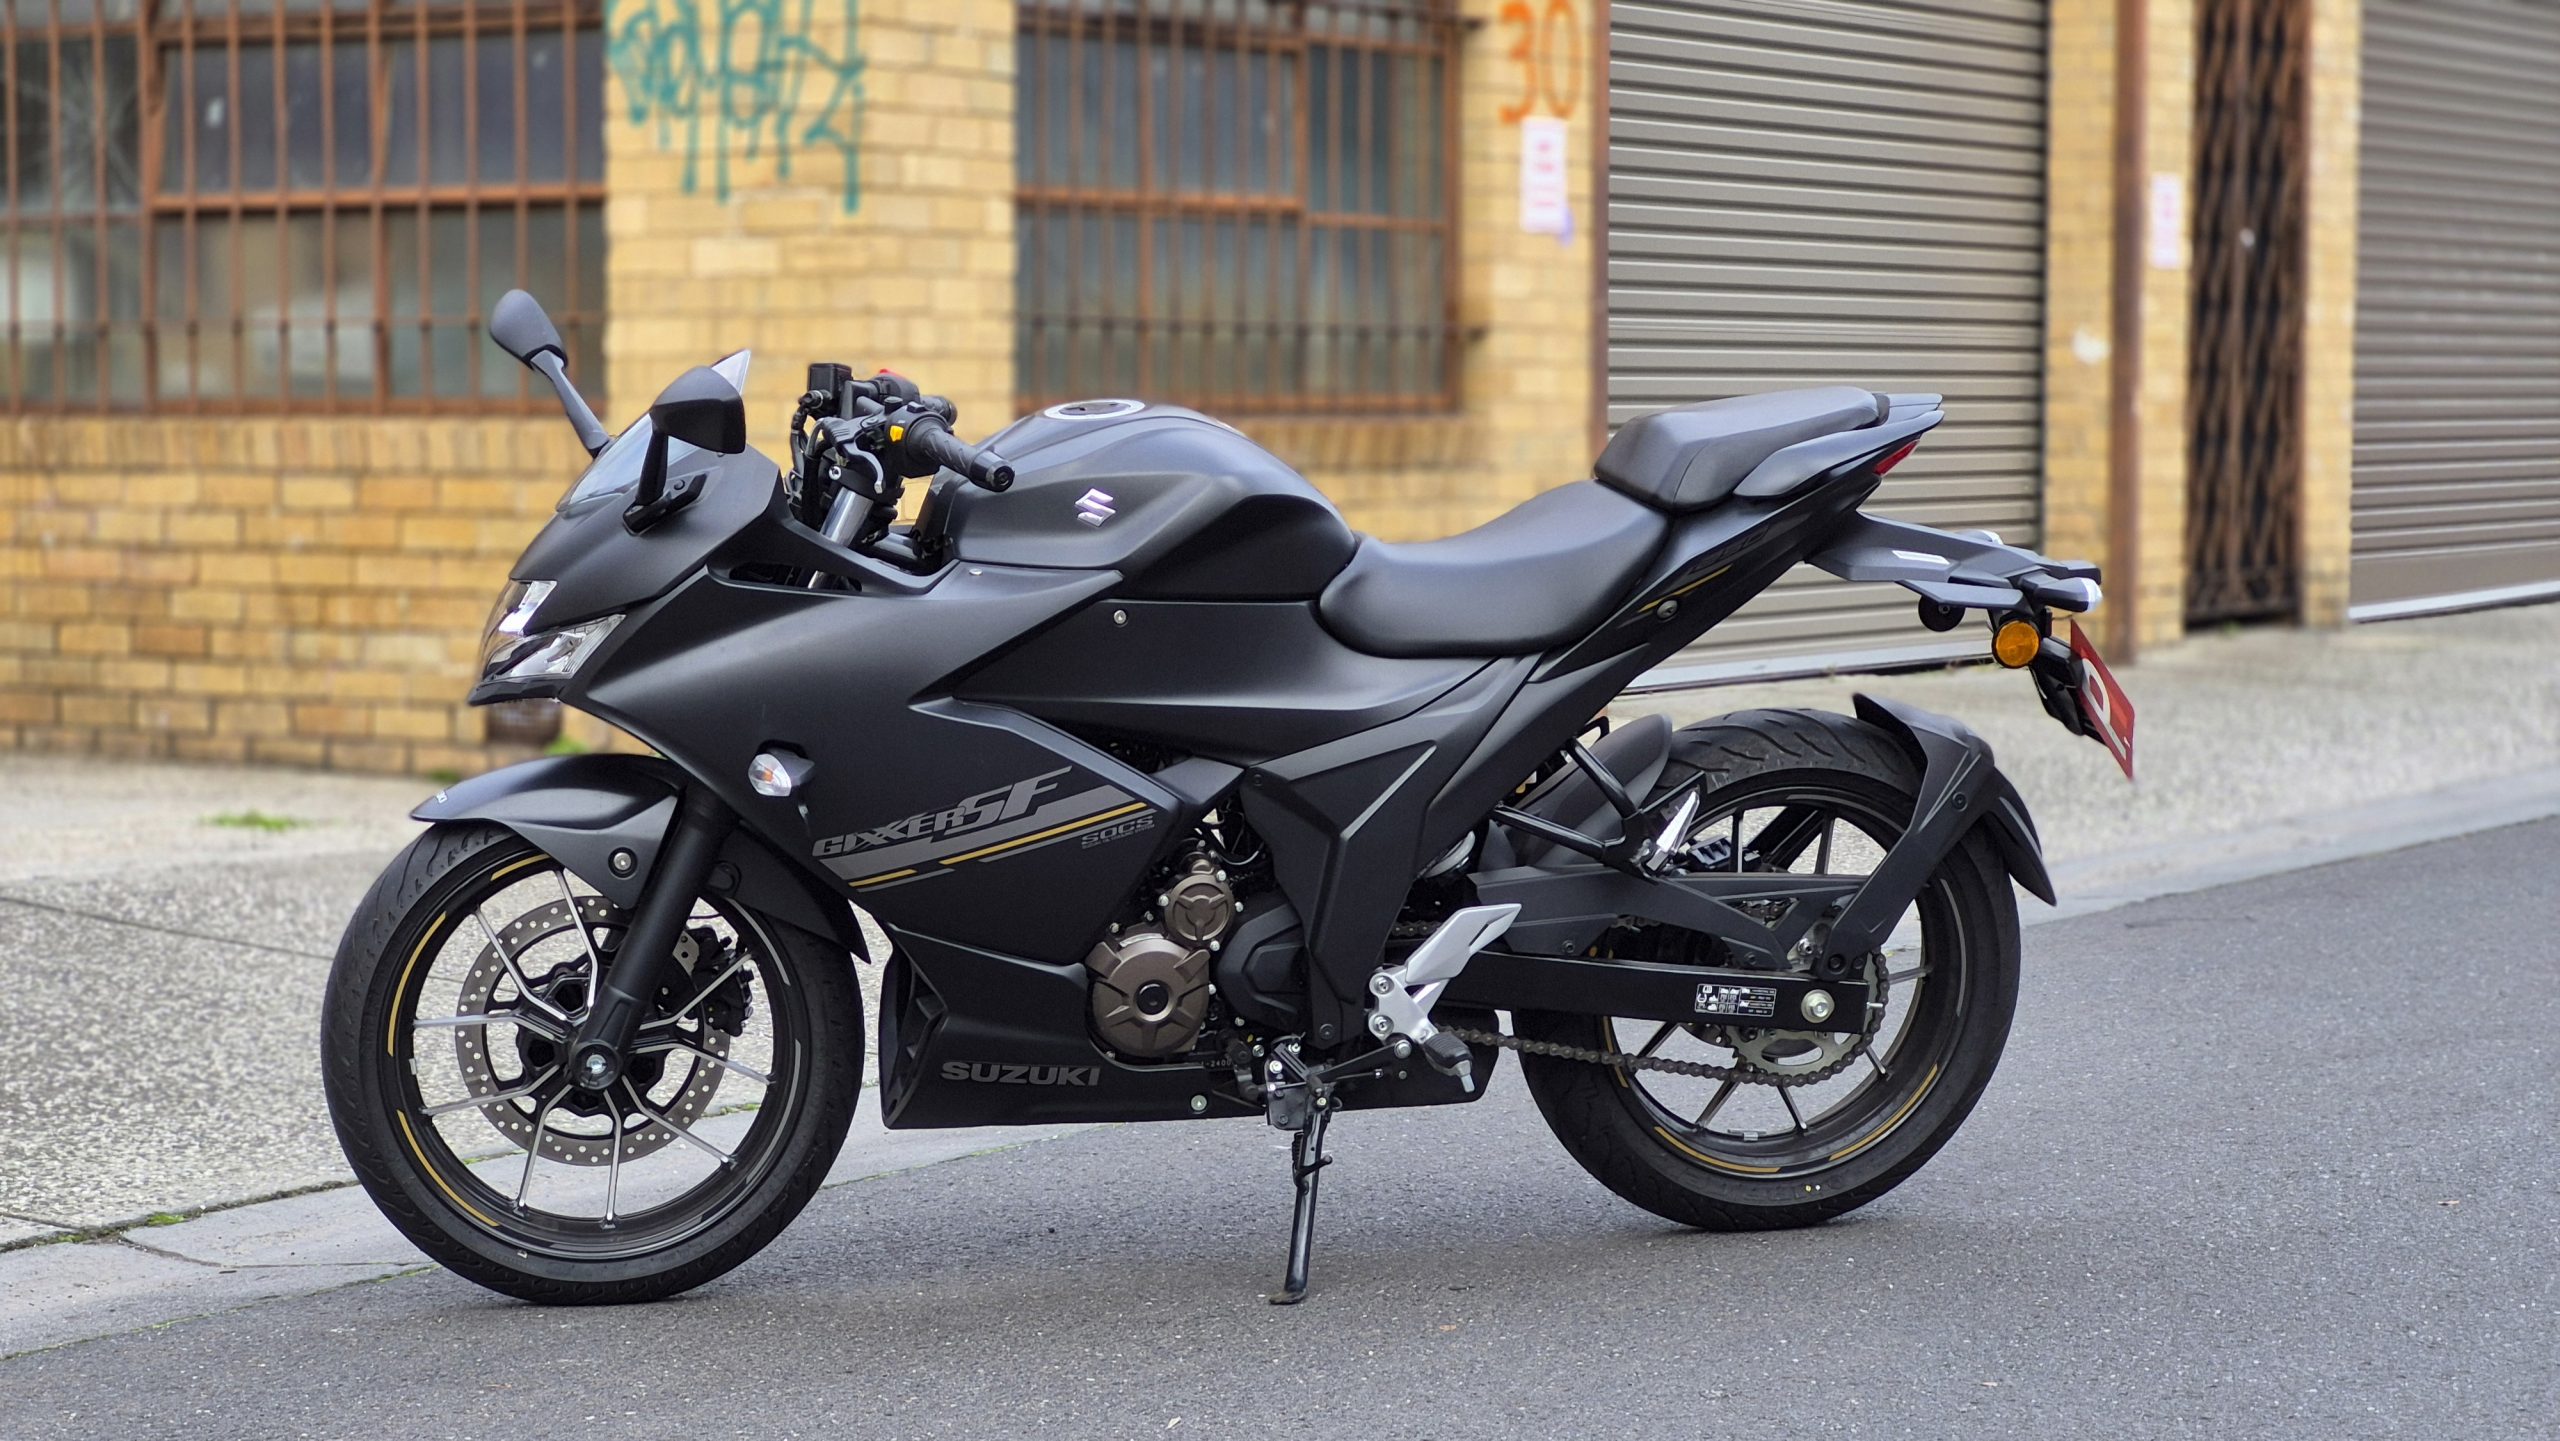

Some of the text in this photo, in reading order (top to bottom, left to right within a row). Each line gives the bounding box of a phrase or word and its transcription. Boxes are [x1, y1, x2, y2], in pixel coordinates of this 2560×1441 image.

[1500, 0, 1581, 124] 30
[812, 766, 1071, 857] GIXXER SF
[1081, 815, 1153, 845] SOCS
[940, 1061, 1100, 1087] SUZUKI
